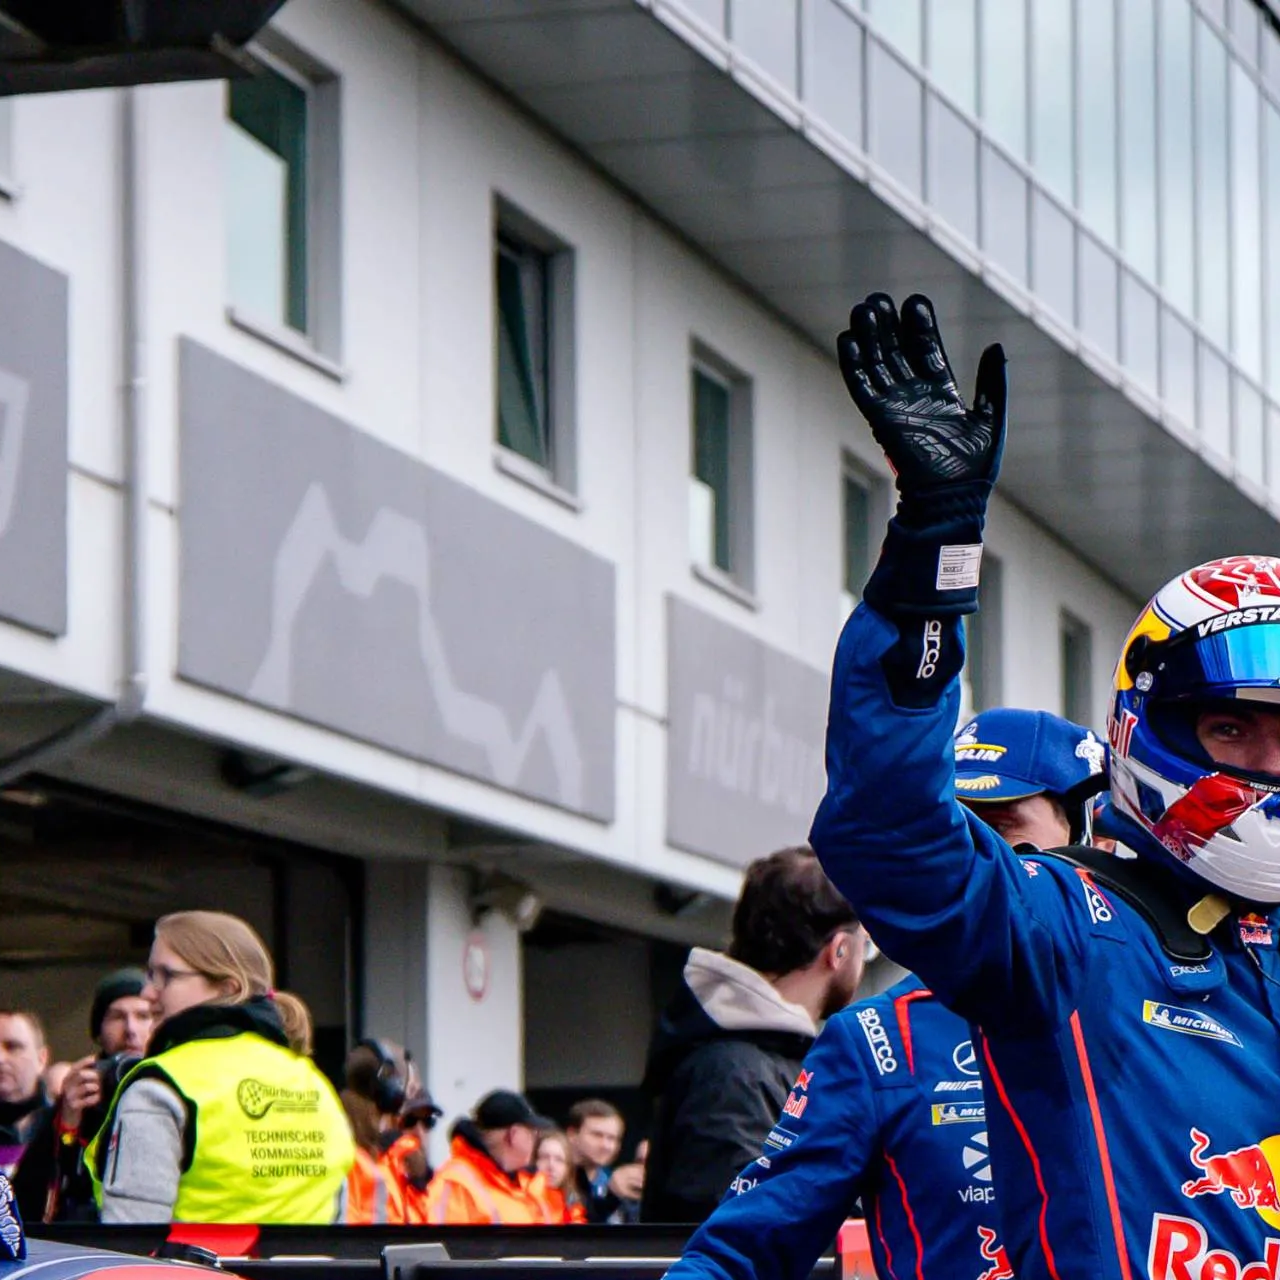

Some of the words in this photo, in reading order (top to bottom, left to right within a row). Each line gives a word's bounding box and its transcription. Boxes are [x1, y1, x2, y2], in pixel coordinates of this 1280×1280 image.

[856, 1006, 898, 1076] sparco
[243, 1130, 326, 1144] TECHNISCHER
[250, 1147, 325, 1160] KOMMISSAR
[251, 1163, 328, 1179] SCRUTINEER
[958, 1184, 996, 1205] viap
